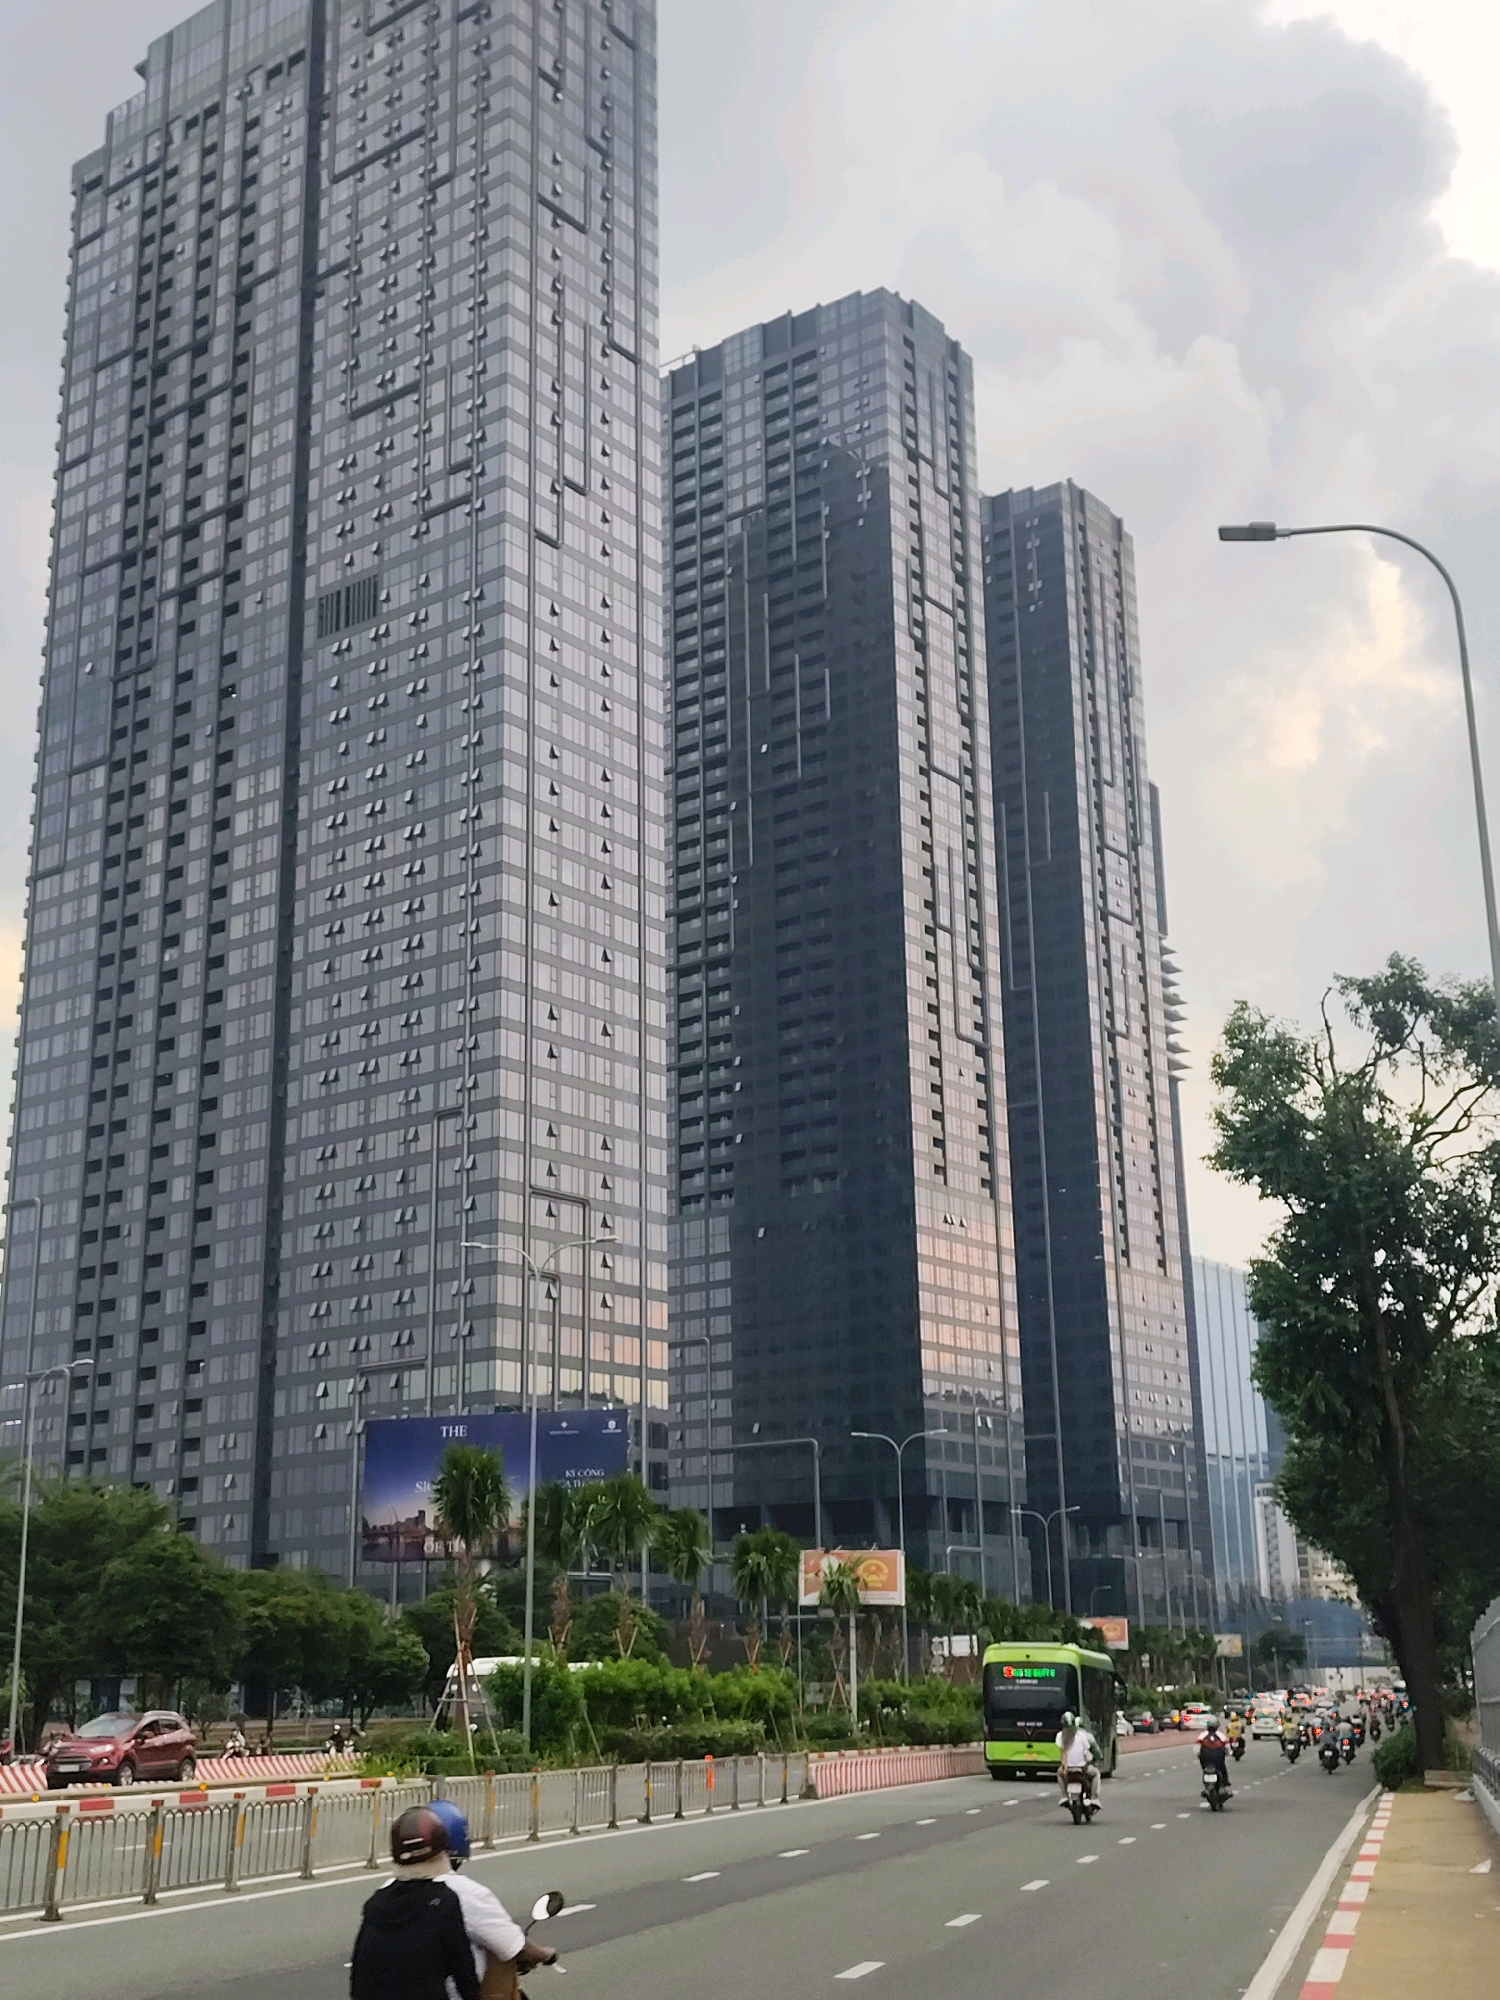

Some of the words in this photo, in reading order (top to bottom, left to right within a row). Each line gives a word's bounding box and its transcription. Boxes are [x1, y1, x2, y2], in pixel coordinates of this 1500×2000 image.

[440, 1425, 468, 1438] THE
[577, 1467, 605, 1478] CÔNG
[423, 1541, 444, 1554] OF
